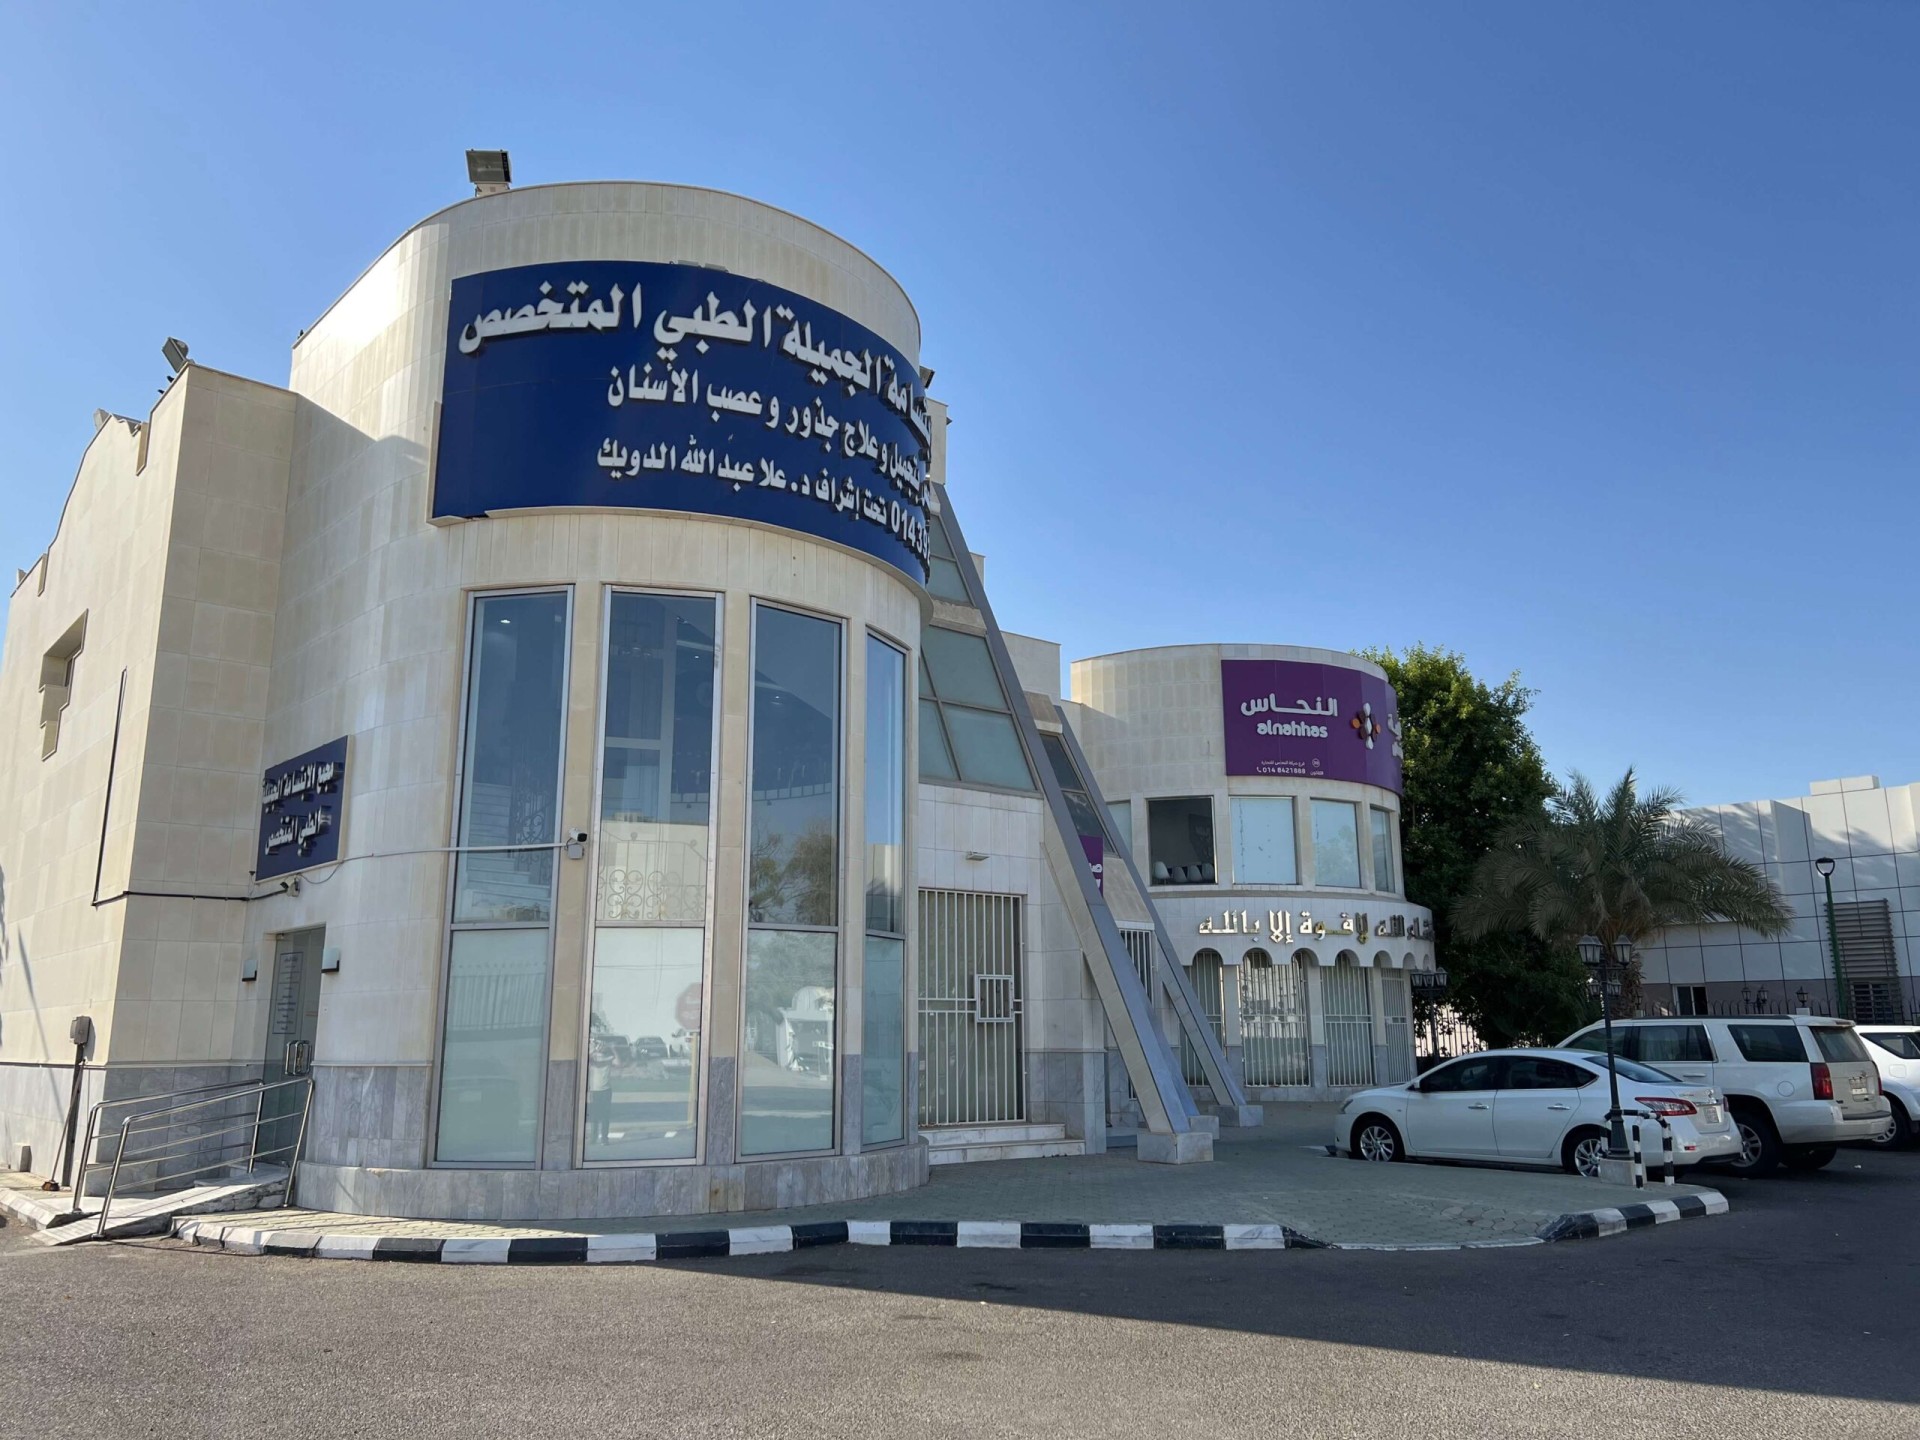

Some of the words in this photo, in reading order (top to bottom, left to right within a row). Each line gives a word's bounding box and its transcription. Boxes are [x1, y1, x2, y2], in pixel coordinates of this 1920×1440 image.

[458, 280, 642, 353] المتخصص
[653, 291, 771, 361] الطبي
[782, 304, 882, 397] الجميلة
[607, 362, 699, 407] الأسنان
[784, 396, 840, 453] جذور
[597, 437, 677, 479] الدويك
[815, 467, 860, 520] إشراف
[863, 488, 887, 525] تحت
[1240, 692, 1338, 717] النحاس
[1256, 719, 1328, 738] alnahhas
[1199, 910, 1261, 943] بالله
[1268, 910, 1294, 944] إلا
